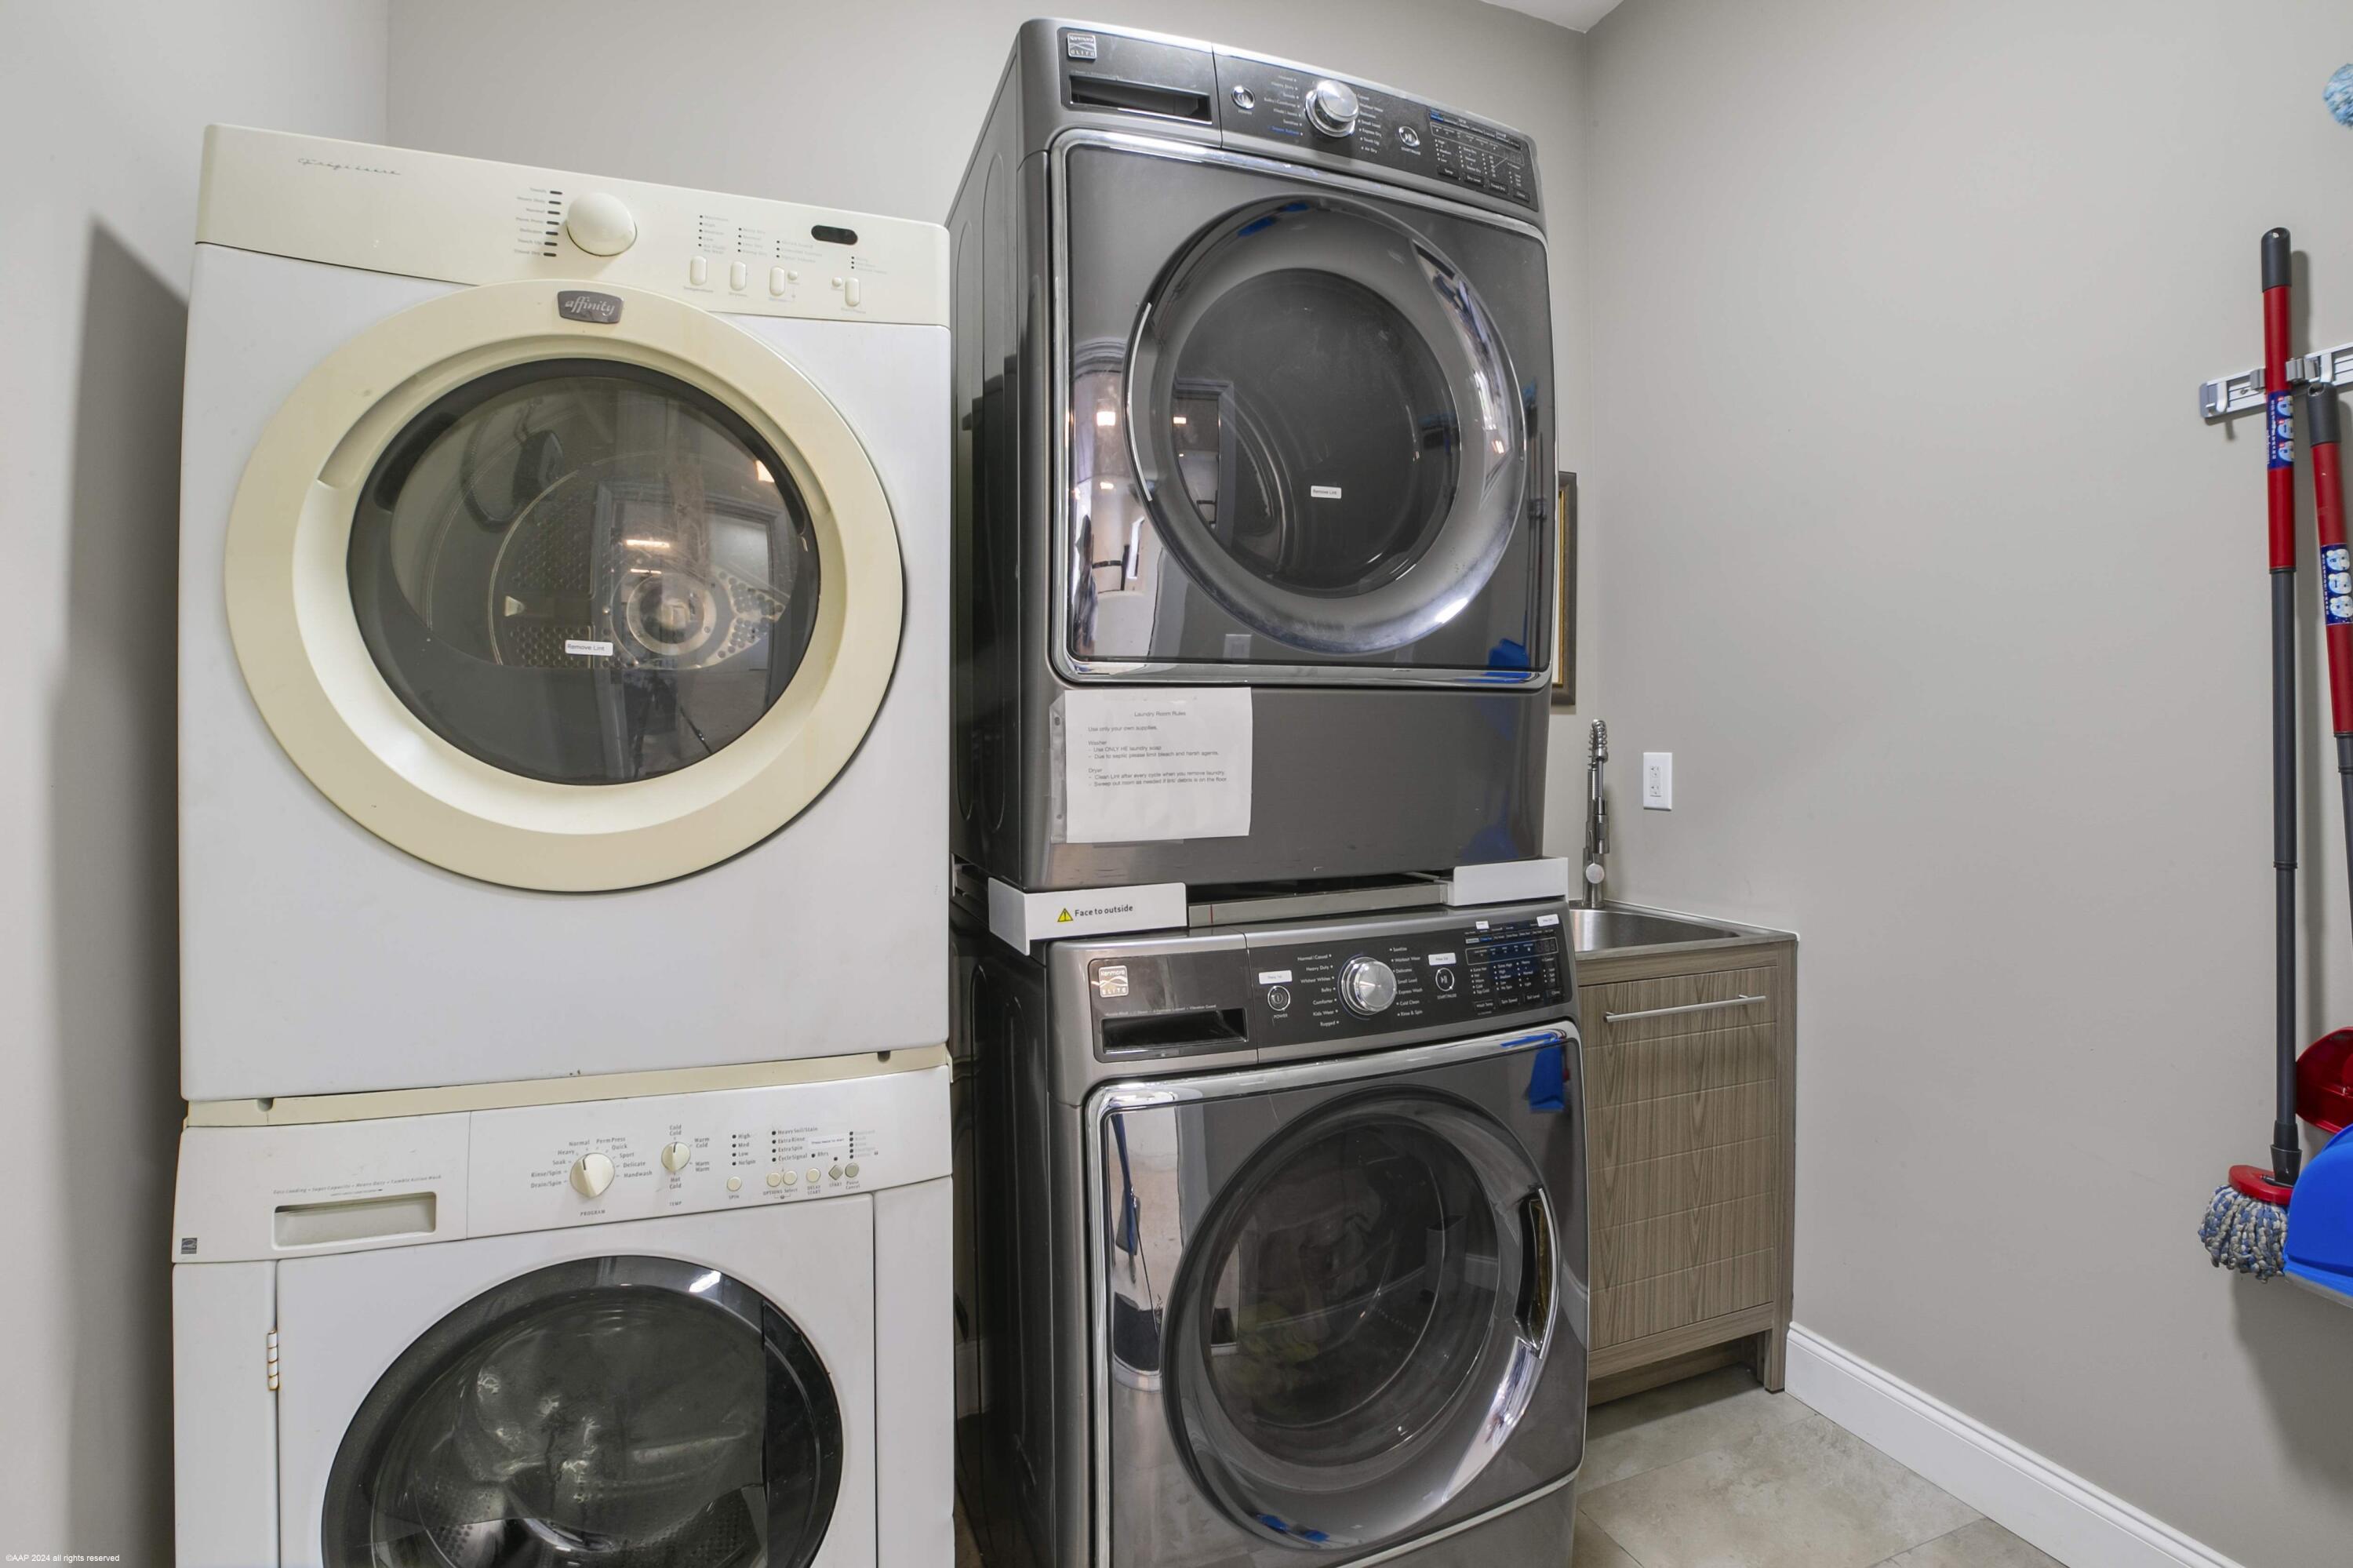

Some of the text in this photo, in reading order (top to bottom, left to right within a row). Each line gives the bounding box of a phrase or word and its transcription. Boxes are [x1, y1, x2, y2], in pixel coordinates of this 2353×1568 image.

[565, 296, 616, 317] affinity
[1104, 904, 1133, 914] outside
[531, 1170, 562, 1178] Rinse/Spin
